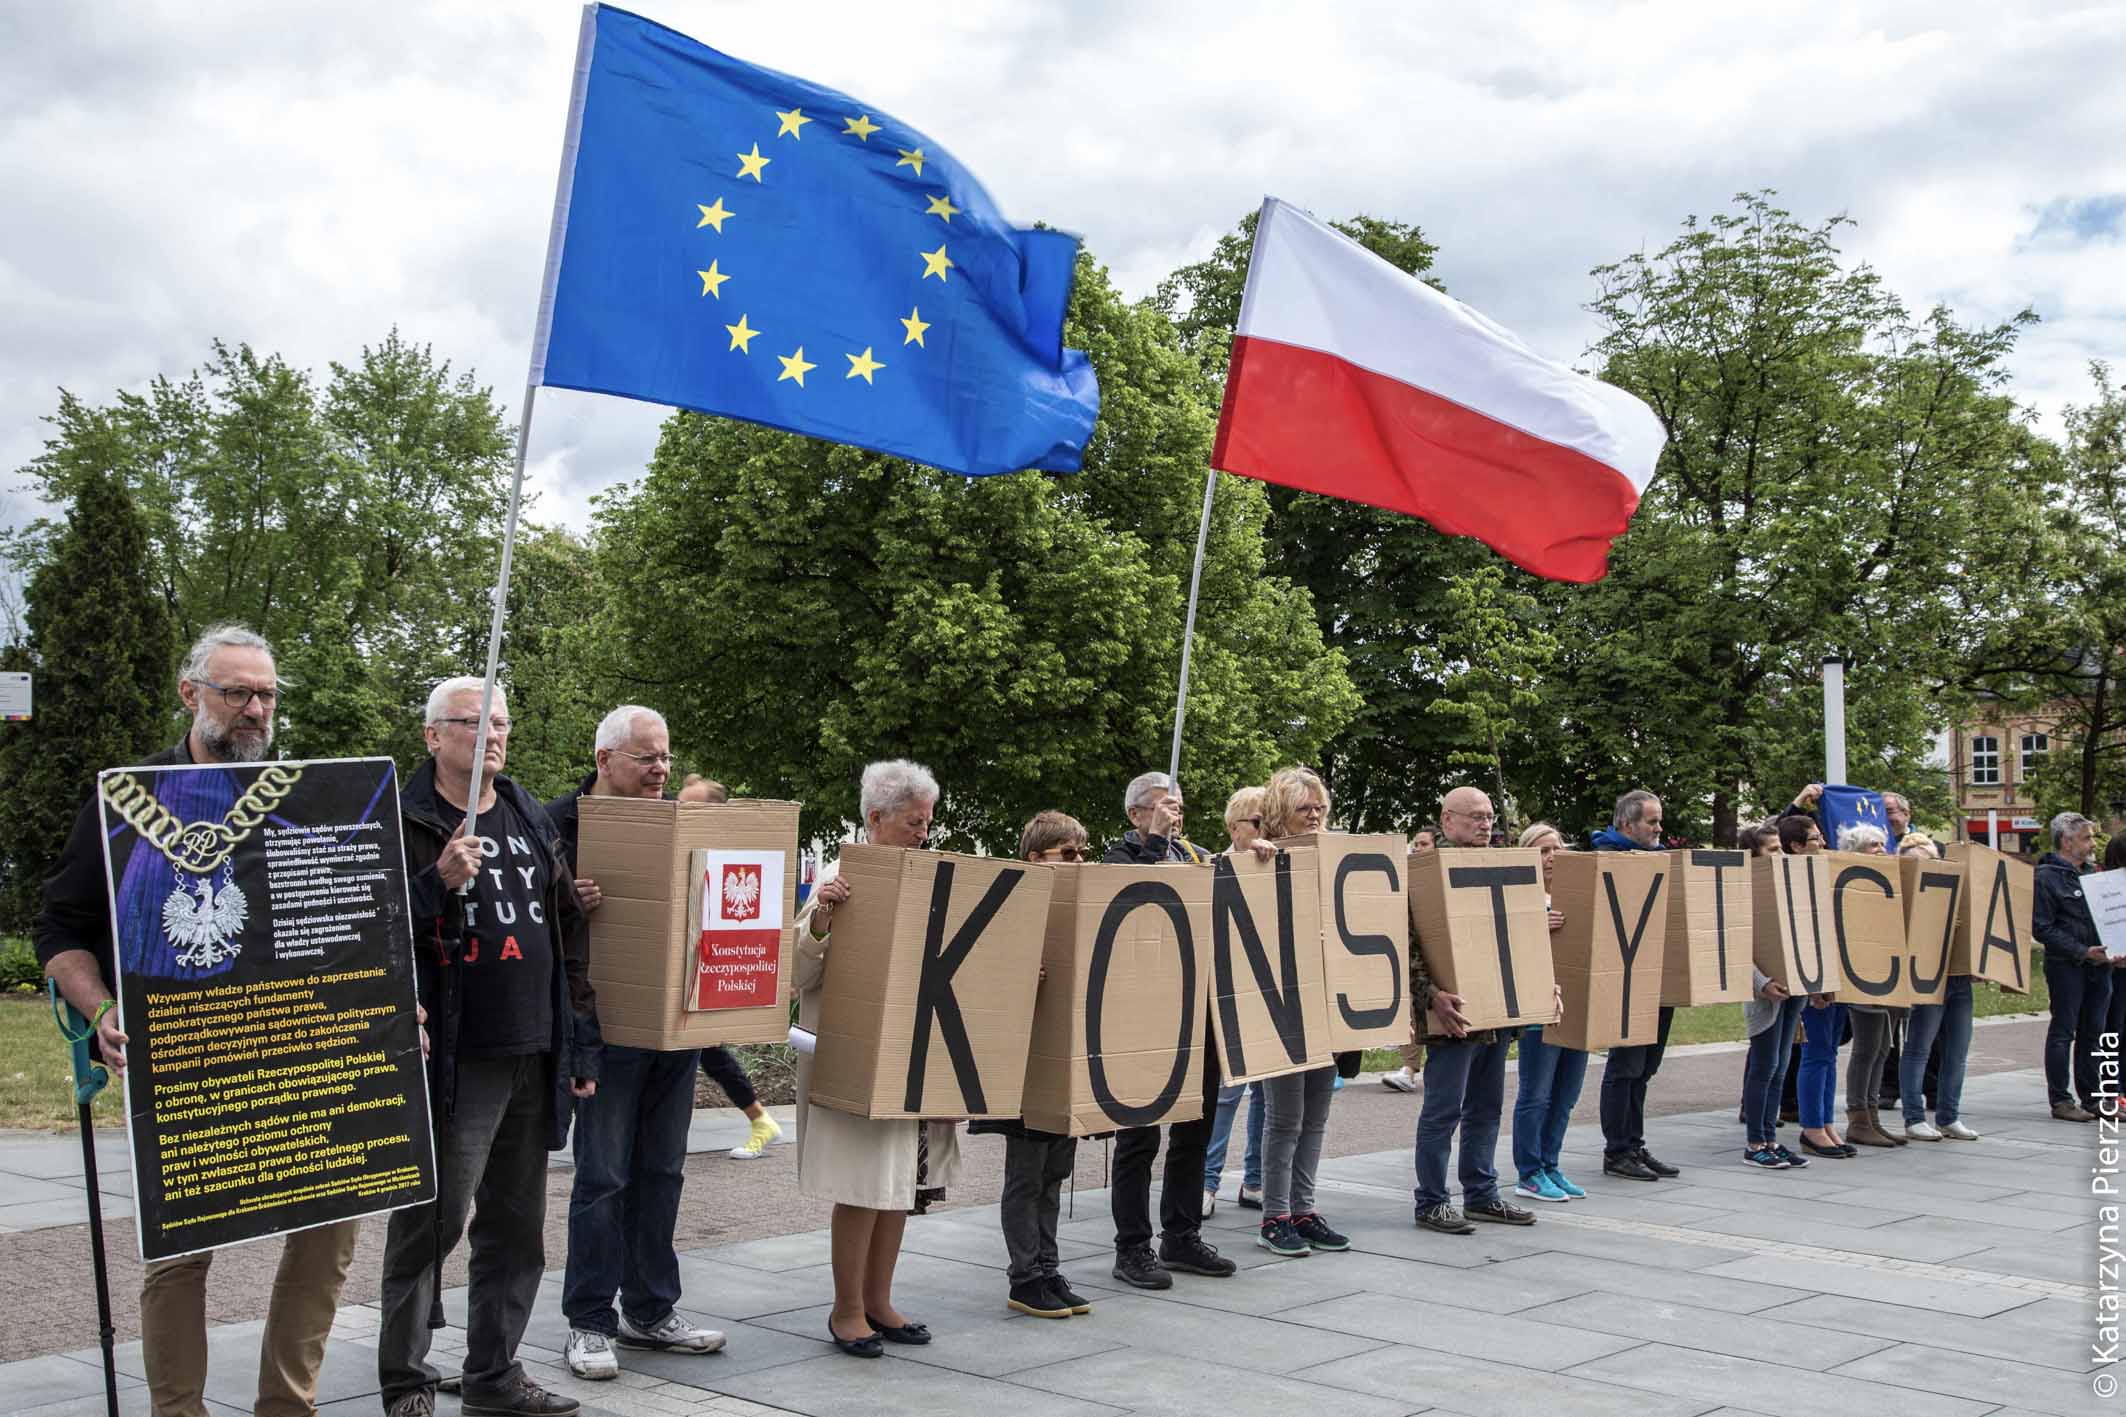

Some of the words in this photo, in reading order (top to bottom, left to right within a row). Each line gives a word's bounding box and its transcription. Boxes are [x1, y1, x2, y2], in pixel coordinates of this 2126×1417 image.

[263, 828, 277, 838] My,
[277, 825, 312, 837] sędziowie
[311, 824, 334, 835] sądów
[334, 820, 383, 833] powszechnych,
[264, 837, 302, 848] otrzymując
[265, 847, 311, 858] ślubowaliśmy
[311, 845, 327, 855] stać
[327, 845, 337, 853] na
[336, 843, 357, 853] straży
[267, 856, 319, 869] sprawiedliwość
[319, 853, 355, 865] wymierzać
[355, 851, 380, 863] zgodnie
[268, 878, 308, 889] bezstronnie
[308, 876, 333, 886] według
[333, 875, 356, 884] swego
[272, 867, 309, 880] przepisami
[271, 899, 303, 910] zasadami
[332, 895, 337, 905] i
[283, 887, 330, 900] postępowaniu
[329, 884, 361, 894] kierować
[360, 882, 371, 892] się
[272, 917, 295, 928] Dzisiaj
[295, 914, 334, 926] sędziowska
[334, 909, 376, 921] niezawisłość
[464, 901, 544, 926] TUC
[274, 940, 286, 949] dla
[285, 937, 310, 947] władzy
[310, 932, 361, 945] ustawodawczej
[299, 926, 310, 937] się
[310, 923, 352, 935] zagrożeniem
[275, 950, 279, 960] i
[278, 946, 325, 960] wykonawczej.
[463, 935, 524, 963] JA
[711, 943, 767, 959] Konstytucja
[146, 991, 203, 1005] Wzywamy
[205, 985, 243, 997] władze
[245, 978, 305, 994] państwowe
[306, 975, 320, 985] do
[321, 967, 387, 984] zaprzestania:
[717, 978, 757, 994] Polskiej
[148, 1004, 186, 1018] działań
[188, 996, 252, 1013] niszczących
[253, 990, 314, 1004] fundamenty
[149, 1013, 244, 1032] demokratycznego
[246, 1006, 291, 1021] państwa
[293, 1001, 327, 1015] prawa,
[150, 1022, 266, 1047] podporządkowywania
[268, 1013, 335, 1030] sądownictwa
[336, 1005, 396, 1022] politycznym
[151, 1045, 205, 1060] ośrodkom
[207, 1036, 268, 1051] decyzyjnym
[270, 1032, 293, 1043] oraz
[294, 1028, 308, 1039] do
[309, 1020, 370, 1037] zakończenia
[152, 1056, 201, 1073] kampanii
[203, 1048, 259, 1068] pomówień
[261, 1041, 313, 1059] przeciwko
[315, 1036, 359, 1050] sędziom.
[154, 1081, 199, 1095] Prosimy
[201, 1070, 255, 1088] obywateli
[257, 1057, 344, 1079] Rzeczypospolitej
[345, 1050, 386, 1065] Polskiej
[155, 1101, 163, 1110] o
[165, 1094, 207, 1108] obronę,
[209, 1091, 221, 1100] w
[223, 1081, 276, 1101] granicach
[278, 1069, 361, 1089] obowiązującego
[363, 1064, 399, 1078] prawa,
[156, 1101, 249, 1123] konstytucyjnego
[250, 1091, 300, 1109] porządku
[301, 1083, 356, 1101] prawnego.
[159, 1134, 180, 1146] Bez
[182, 1120, 252, 1141] niezależnych
[254, 1115, 290, 1129] sądów
[292, 1111, 308, 1122] nie
[310, 1109, 327, 1119] ma
[328, 1103, 345, 1116] ani
[346, 1094, 406, 1113] demokracji,
[160, 1146, 178, 1159] ani
[180, 1138, 240, 1155] należytego
[242, 1130, 288, 1147] poziomu
[290, 1121, 332, 1136] ochrony
[162, 1161, 191, 1175] praw
[192, 1156, 197, 1168] i
[198, 1147, 248, 1166] wolności
[250, 1134, 329, 1156] obywatelskich,
[162, 1177, 175, 1187] w
[176, 1173, 199, 1186] tym
[201, 1162, 257, 1180] zwłaszcza
[258, 1155, 293, 1171] prawa
[294, 1151, 308, 1162] do
[310, 1142, 365, 1159] rzetelnego
[366, 1134, 410, 1150] procesu,
[164, 1187, 182, 1201] ani
[183, 1184, 201, 1197] też
[203, 1175, 255, 1193] szacunku
[257, 1171, 274, 1183] dla
[276, 1160, 324, 1181] godności
[325, 1152, 368, 1169] ludzkiej.
